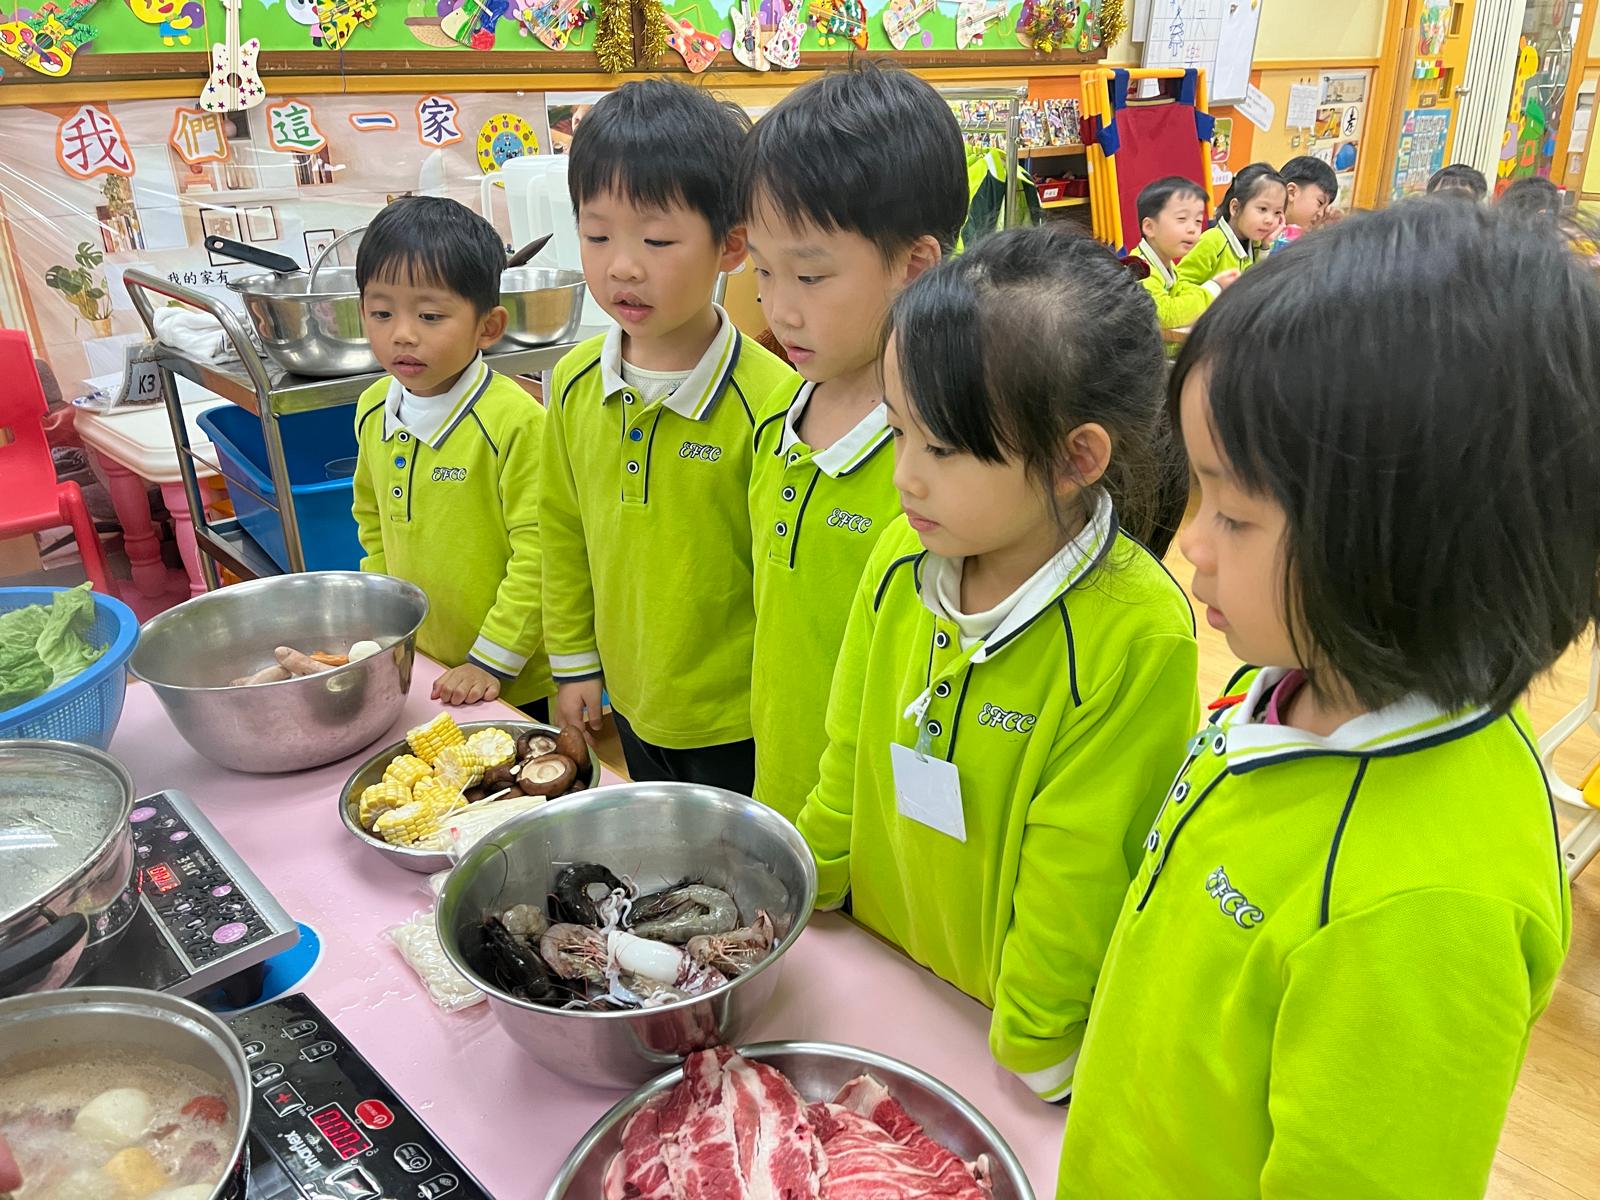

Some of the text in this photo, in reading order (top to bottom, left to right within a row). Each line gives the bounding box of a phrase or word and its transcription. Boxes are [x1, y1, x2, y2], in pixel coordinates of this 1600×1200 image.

[65, 98, 459, 171] 我們這一家
[168, 269, 229, 286] 我的家有
[138, 374, 156, 394] K3
[680, 441, 721, 462] EFCC
[432, 467, 467, 481] EFCC
[827, 508, 872, 533] EFCC
[978, 703, 1036, 733] EFCC
[1206, 865, 1264, 929] EFCC
[284, 1130, 322, 1173] imarflex
